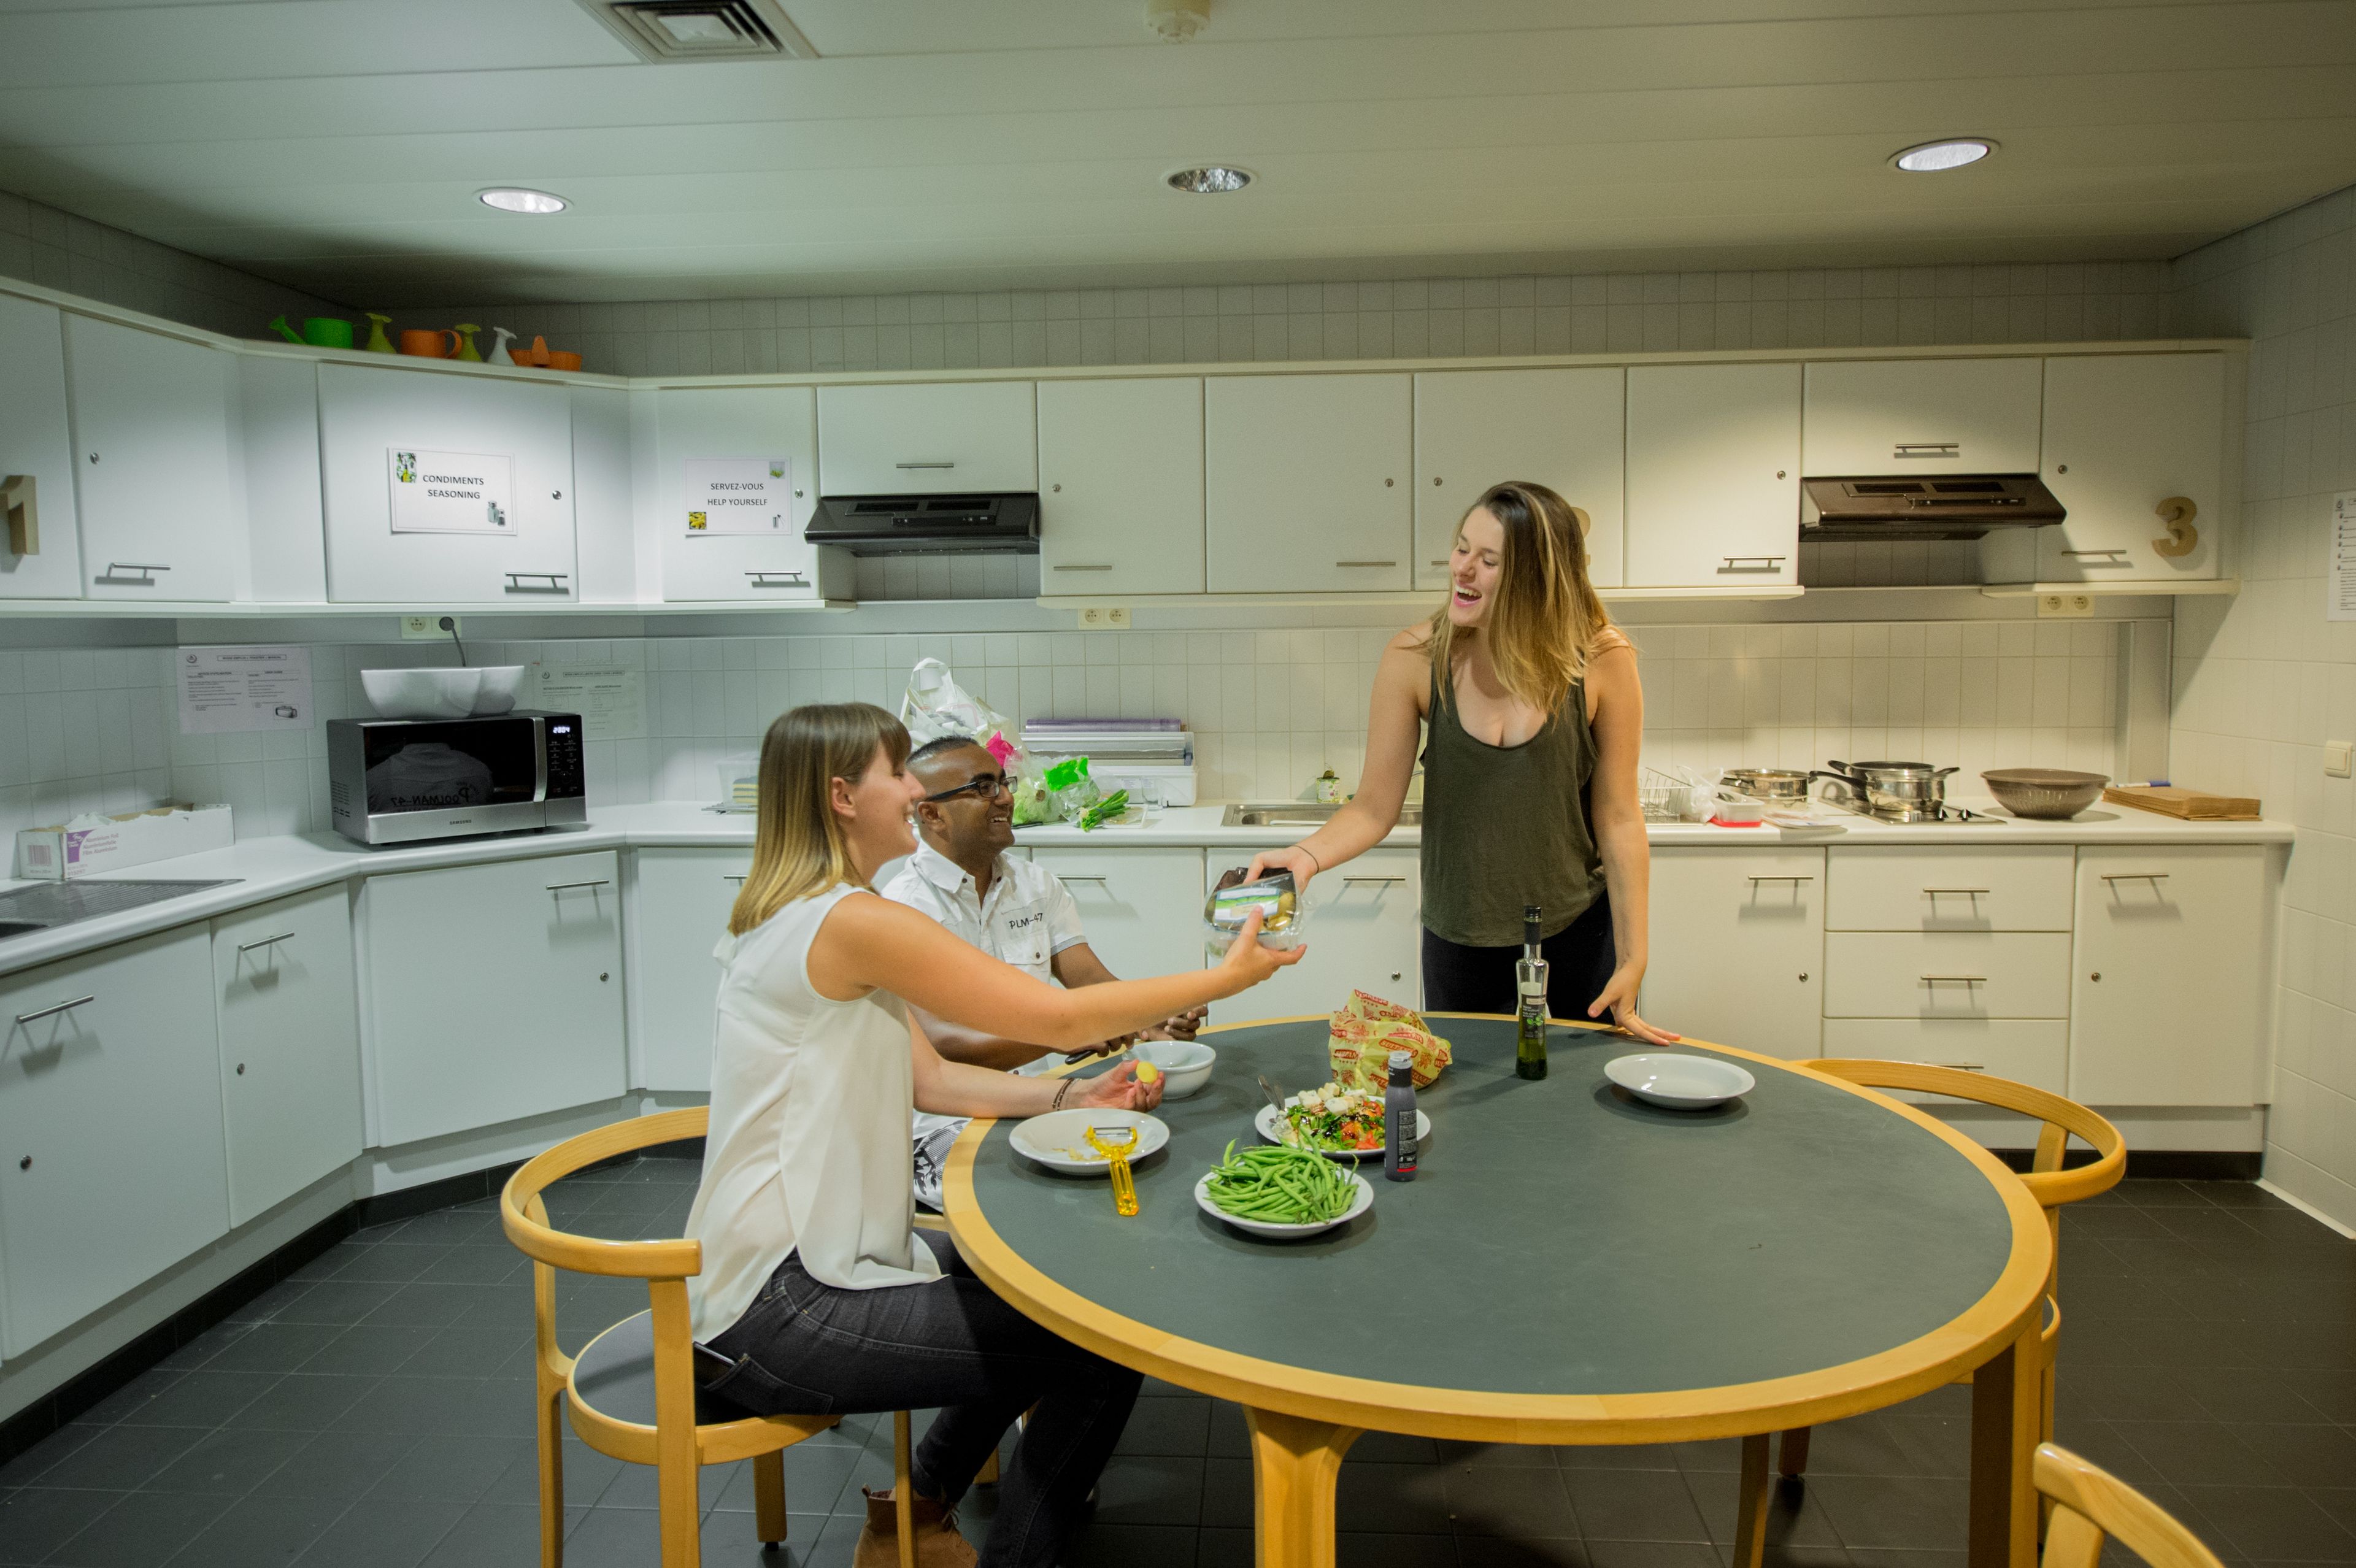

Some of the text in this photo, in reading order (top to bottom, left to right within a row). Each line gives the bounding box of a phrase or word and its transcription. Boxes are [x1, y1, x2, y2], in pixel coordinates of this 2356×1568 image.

[423, 475, 484, 485] CONDIMENTS
[428, 490, 480, 499] SEASONING
[2152, 496, 2198, 557] 3
[1008, 912, 1044, 930] PLM-47
